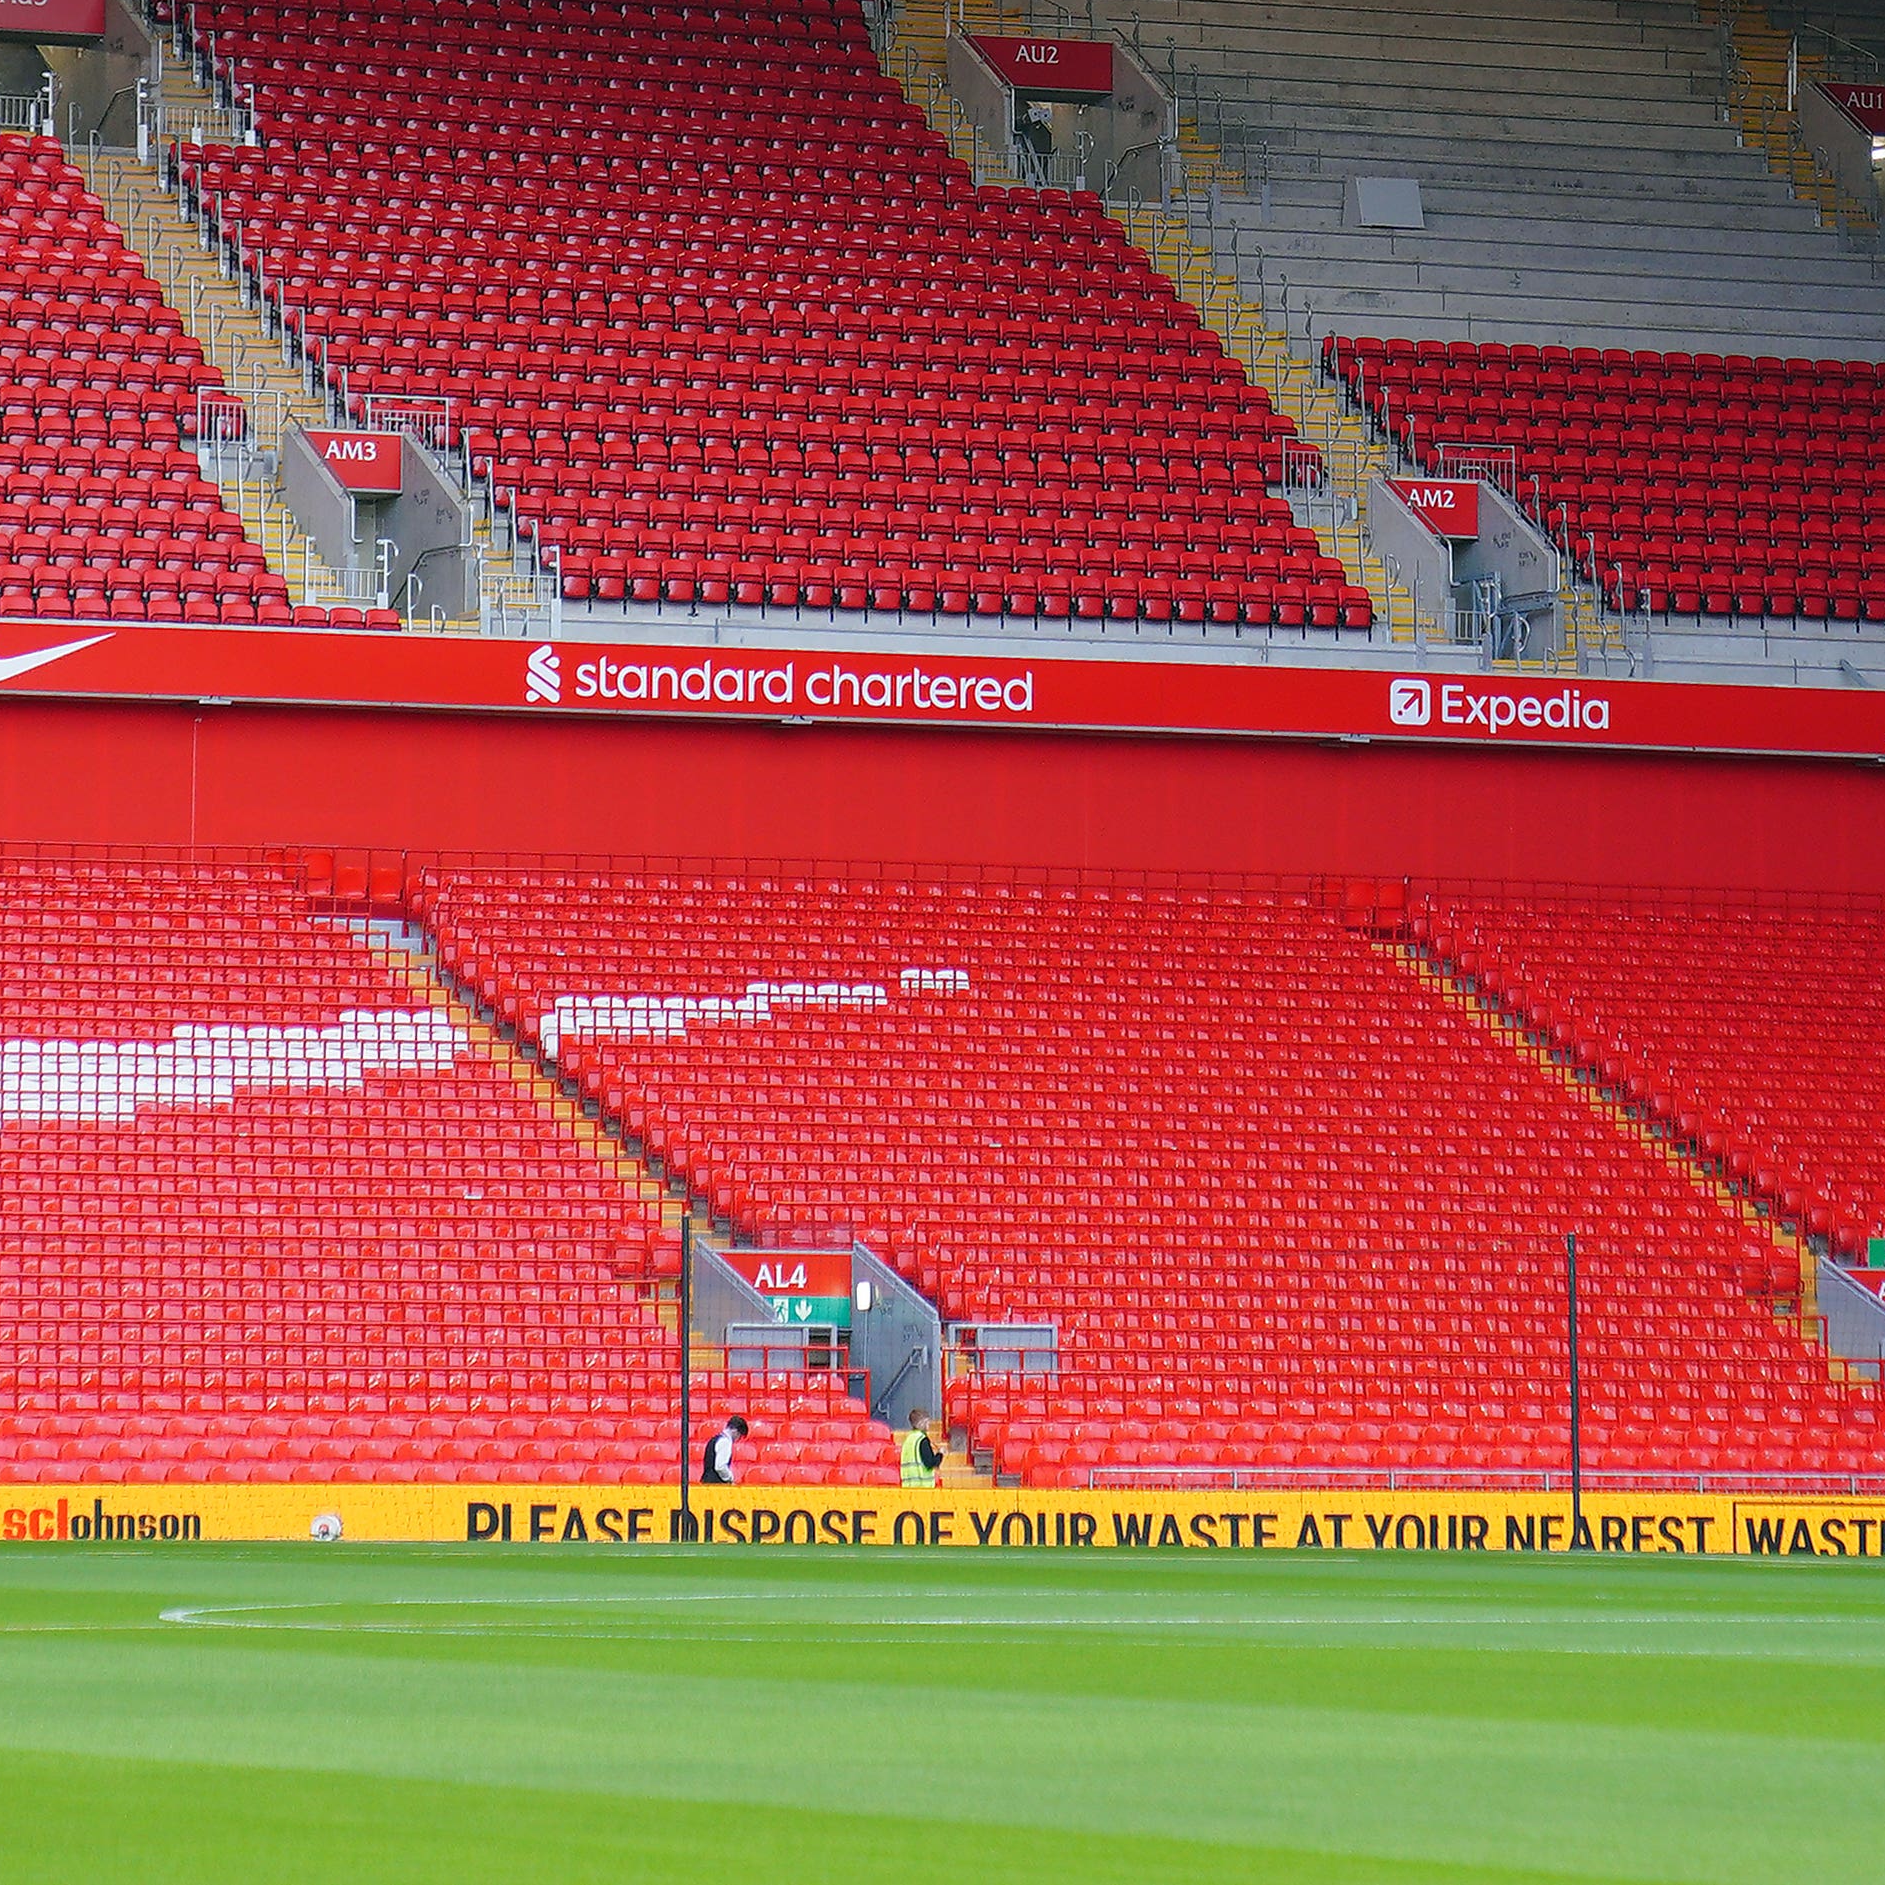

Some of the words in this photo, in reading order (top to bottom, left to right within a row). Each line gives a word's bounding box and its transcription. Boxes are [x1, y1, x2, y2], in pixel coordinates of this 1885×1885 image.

[1015, 44, 1059, 64] AU2
[1846, 91, 1884, 109] AU1
[324, 439, 376, 461] AM3
[1408, 489, 1456, 509] AM2
[575, 655, 793, 703] standard
[805, 664, 1033, 711] chartered
[1442, 685, 1609, 734] Expedia
[754, 1263, 808, 1289] AL4
[467, 1502, 654, 1543] PLEASE
[670, 1508, 877, 1544] DISPOSE
[892, 1511, 955, 1546] OF
[968, 1512, 1096, 1547] YOUR
[1111, 1513, 1278, 1548] WASTE
[1295, 1513, 1352, 1548] AT
[1364, 1514, 1489, 1550] YOUR
[1506, 1515, 1715, 1554] NEAREST
